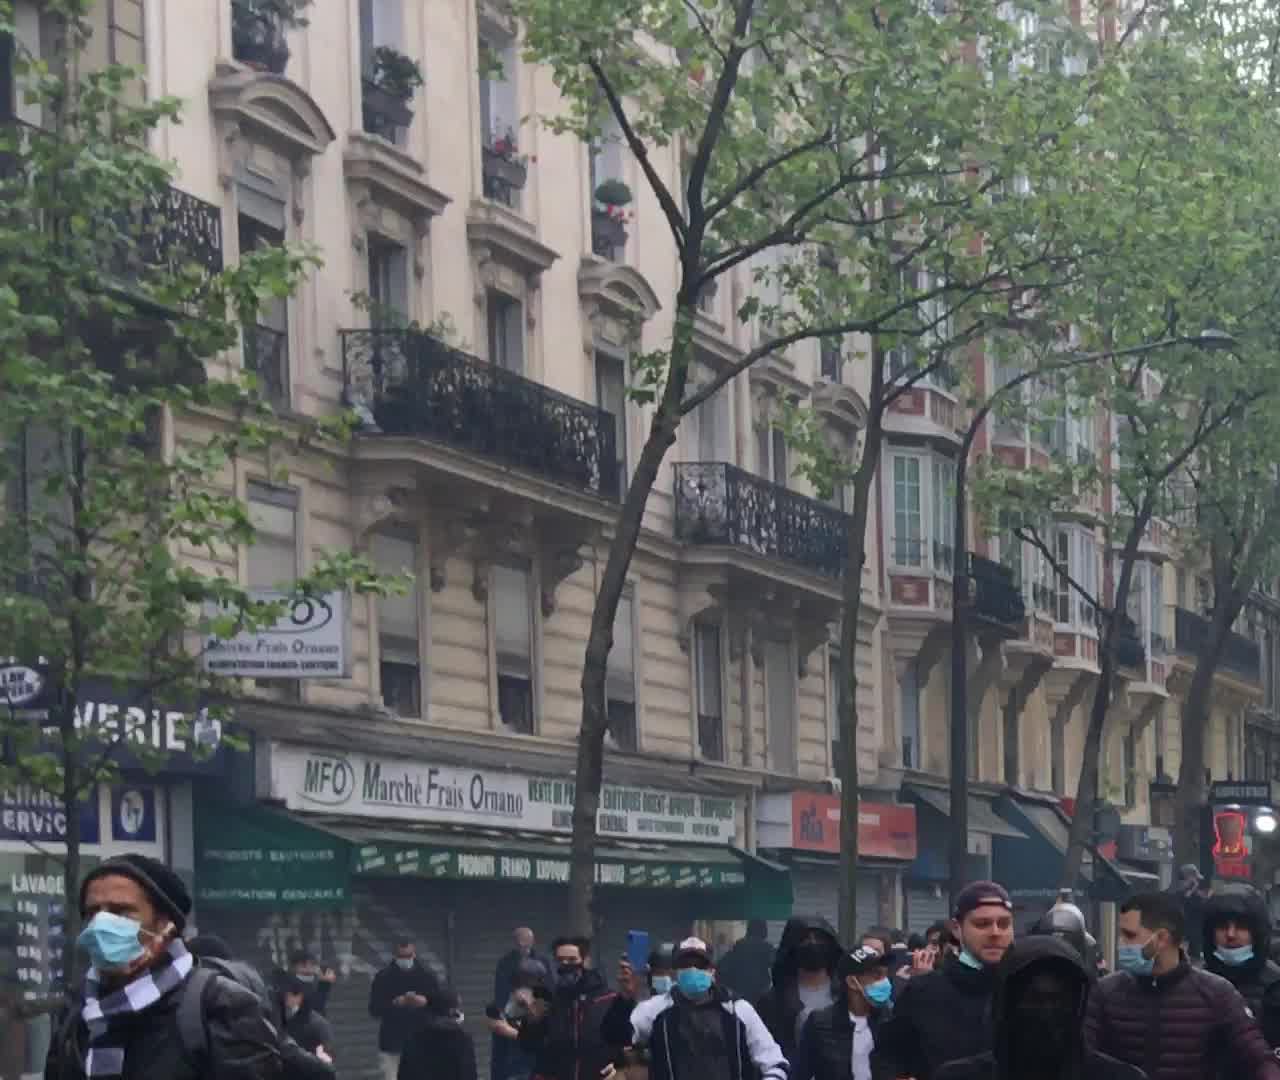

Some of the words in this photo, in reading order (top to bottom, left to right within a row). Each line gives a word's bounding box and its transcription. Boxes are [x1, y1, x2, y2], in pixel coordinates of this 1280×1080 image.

[304, 759, 346, 795] MFO
[427, 767, 464, 809] Frais
[470, 773, 523, 815] Ornano
